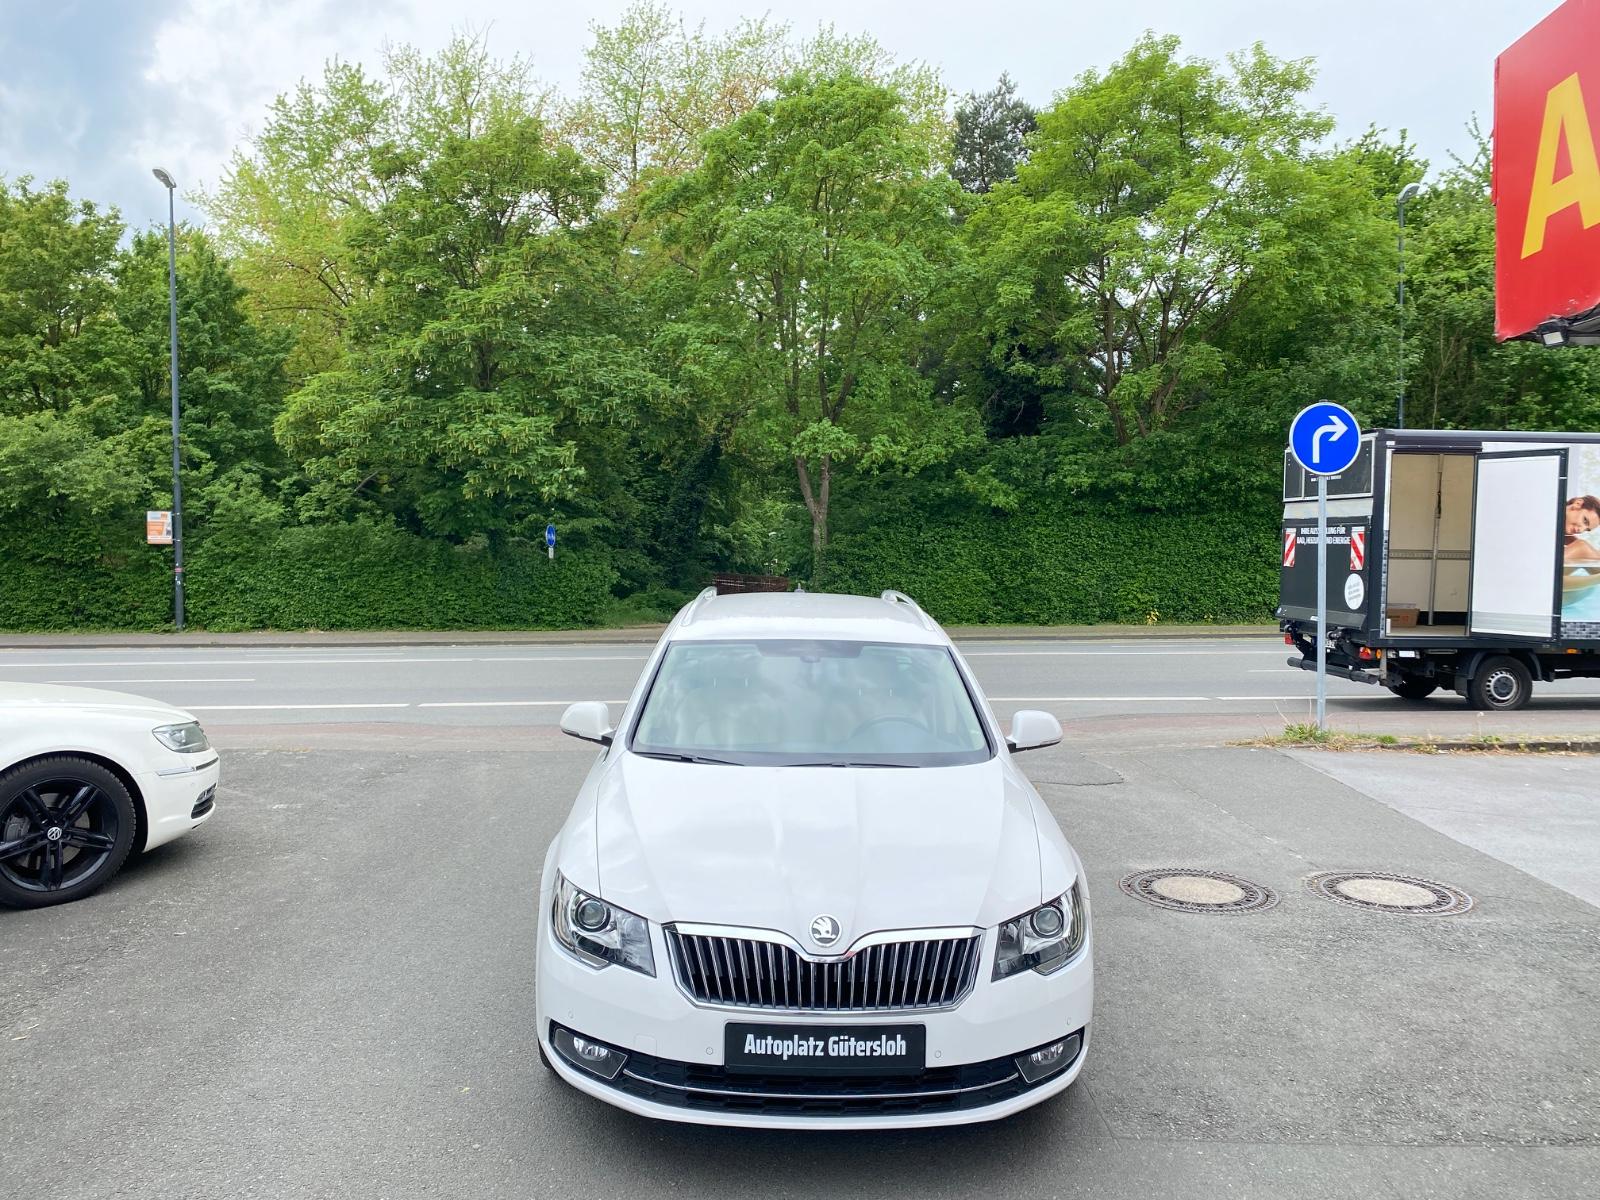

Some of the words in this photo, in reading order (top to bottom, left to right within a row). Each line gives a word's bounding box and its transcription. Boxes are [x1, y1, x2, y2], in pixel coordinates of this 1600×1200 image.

[1520, 72, 1600, 260] A
[744, 1033, 825, 1060] Autoplatz
[828, 1034, 907, 1057] Gütersloh
